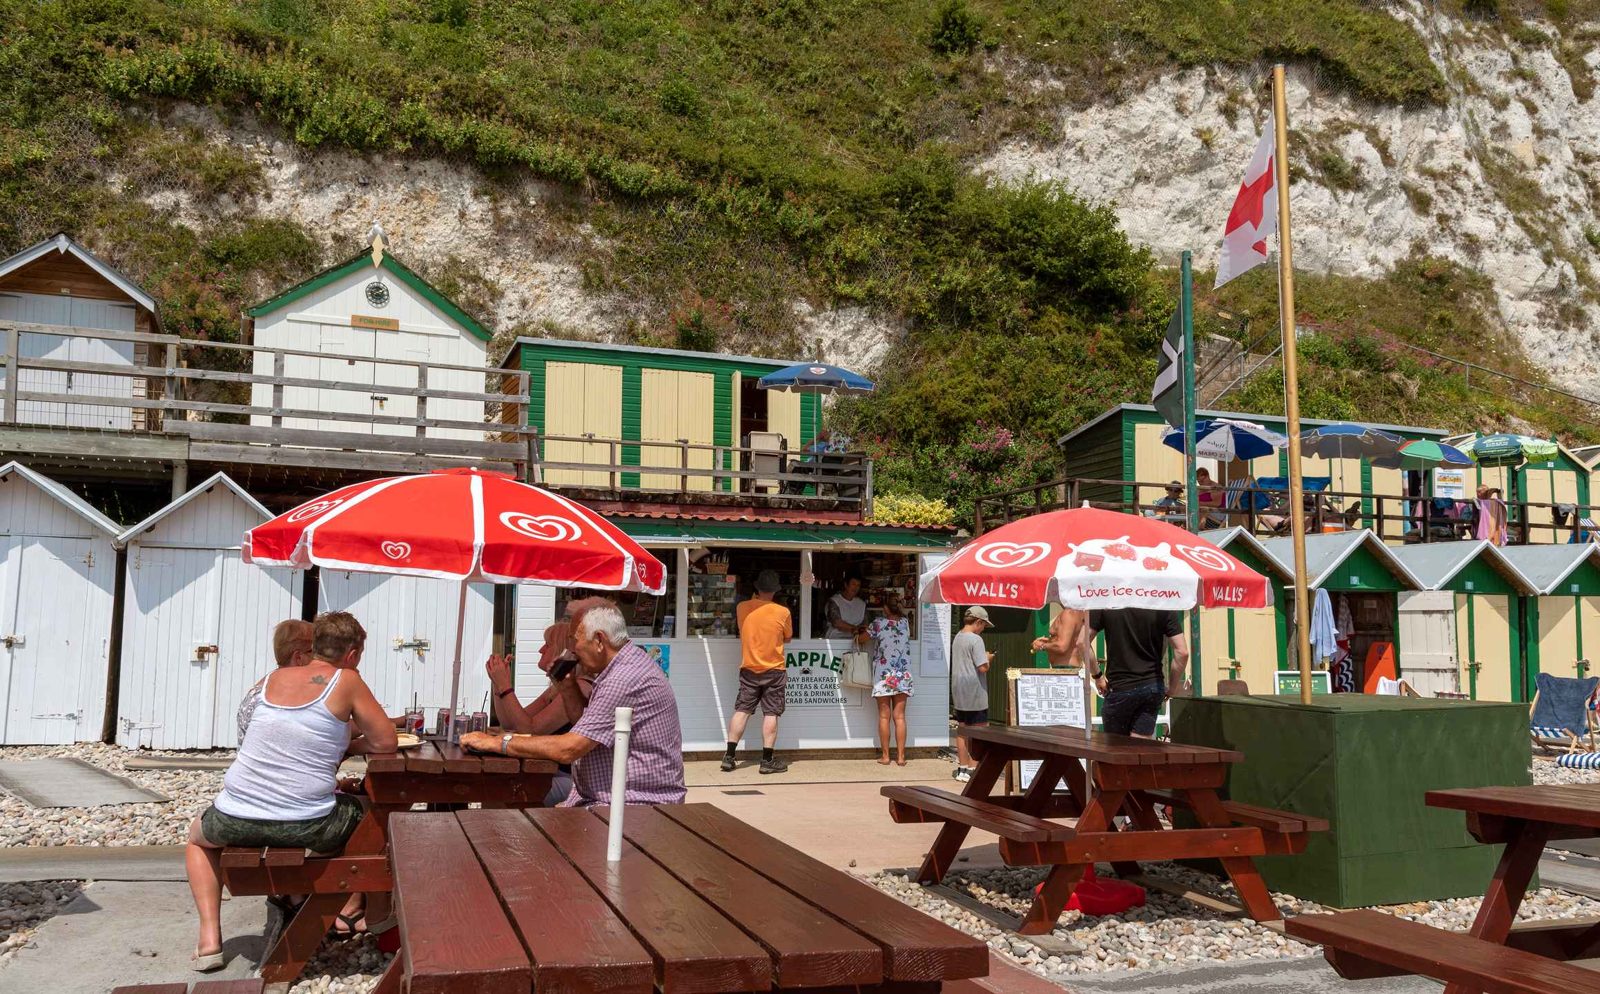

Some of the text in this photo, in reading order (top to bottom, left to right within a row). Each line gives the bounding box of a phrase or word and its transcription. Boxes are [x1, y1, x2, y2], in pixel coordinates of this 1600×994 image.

[963, 581, 1019, 599] WALL'S
[1077, 584, 1181, 599] Love ice cream
